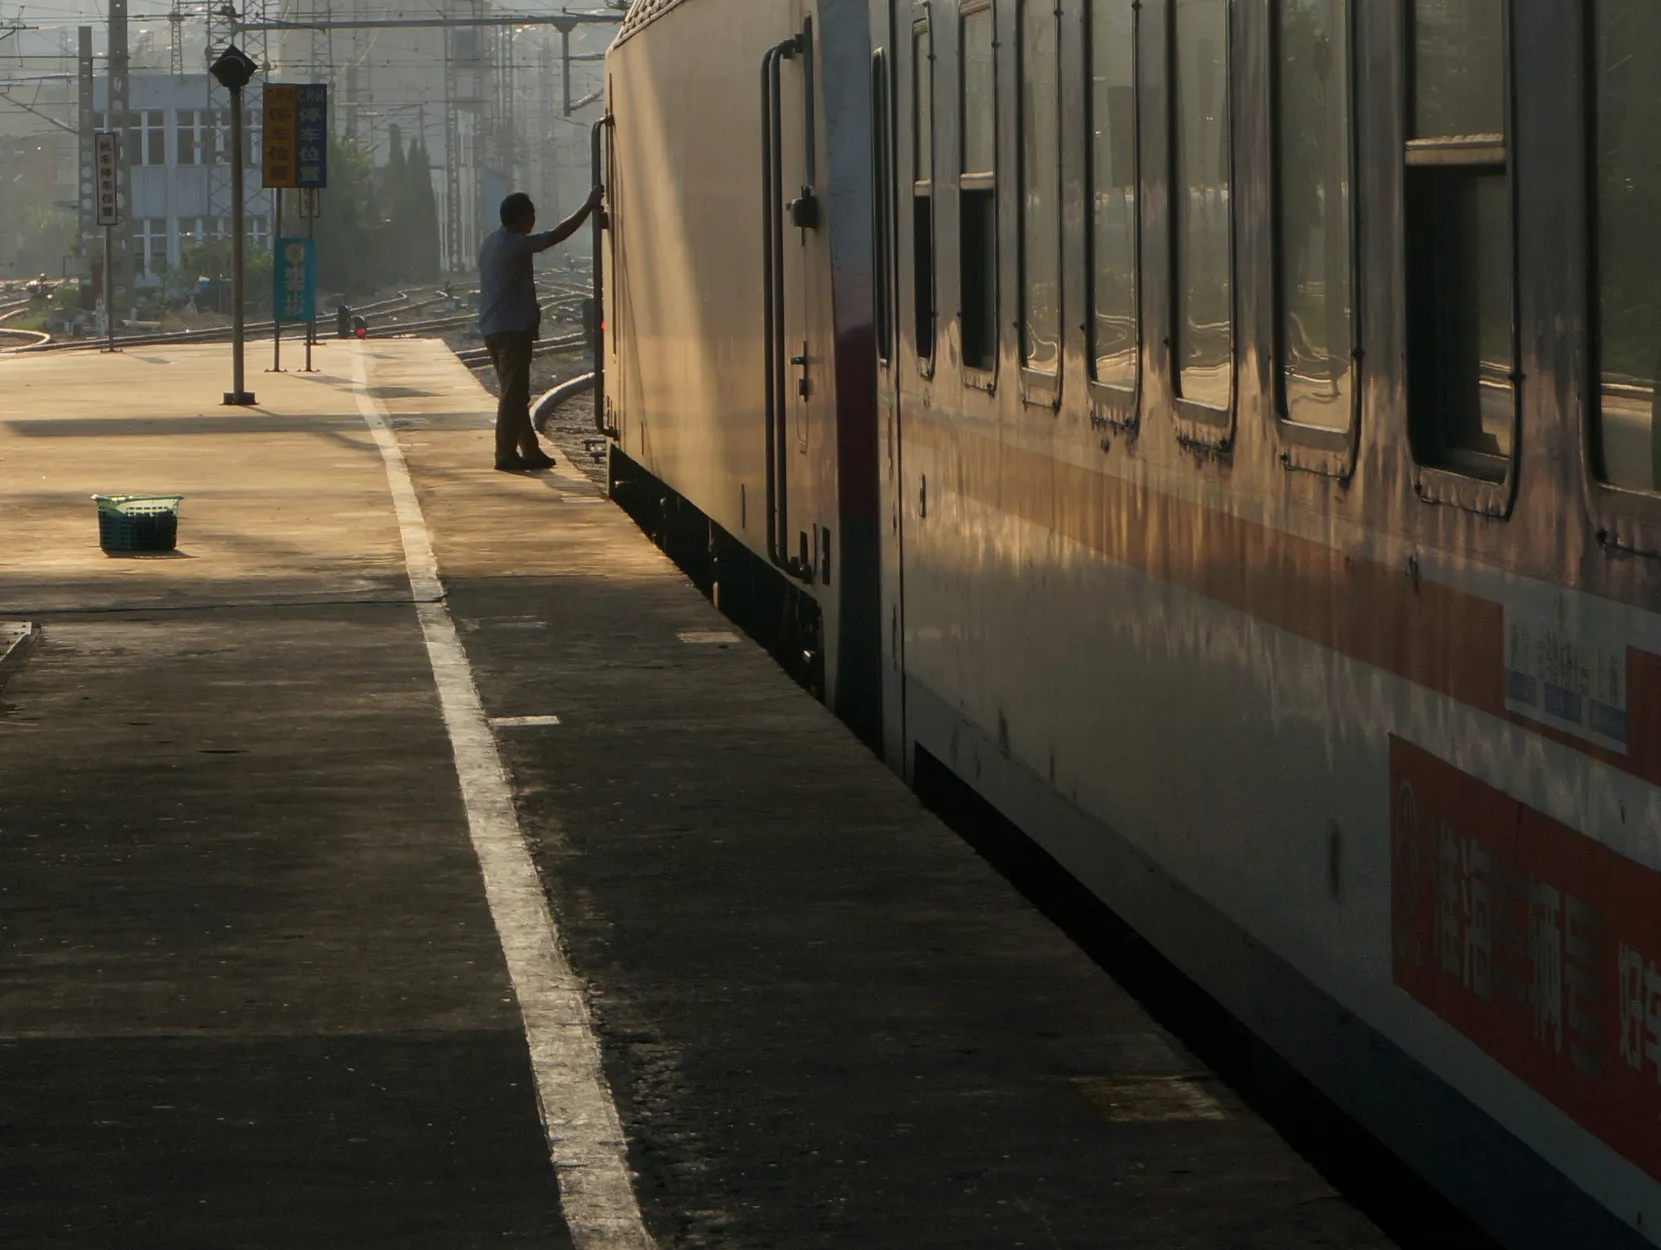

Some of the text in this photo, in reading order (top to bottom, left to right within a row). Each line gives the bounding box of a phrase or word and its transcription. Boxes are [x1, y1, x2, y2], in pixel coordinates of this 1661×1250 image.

[297, 89, 324, 102] CRH
[267, 106, 293, 181] 停车位置
[298, 106, 323, 181] 停车位置
